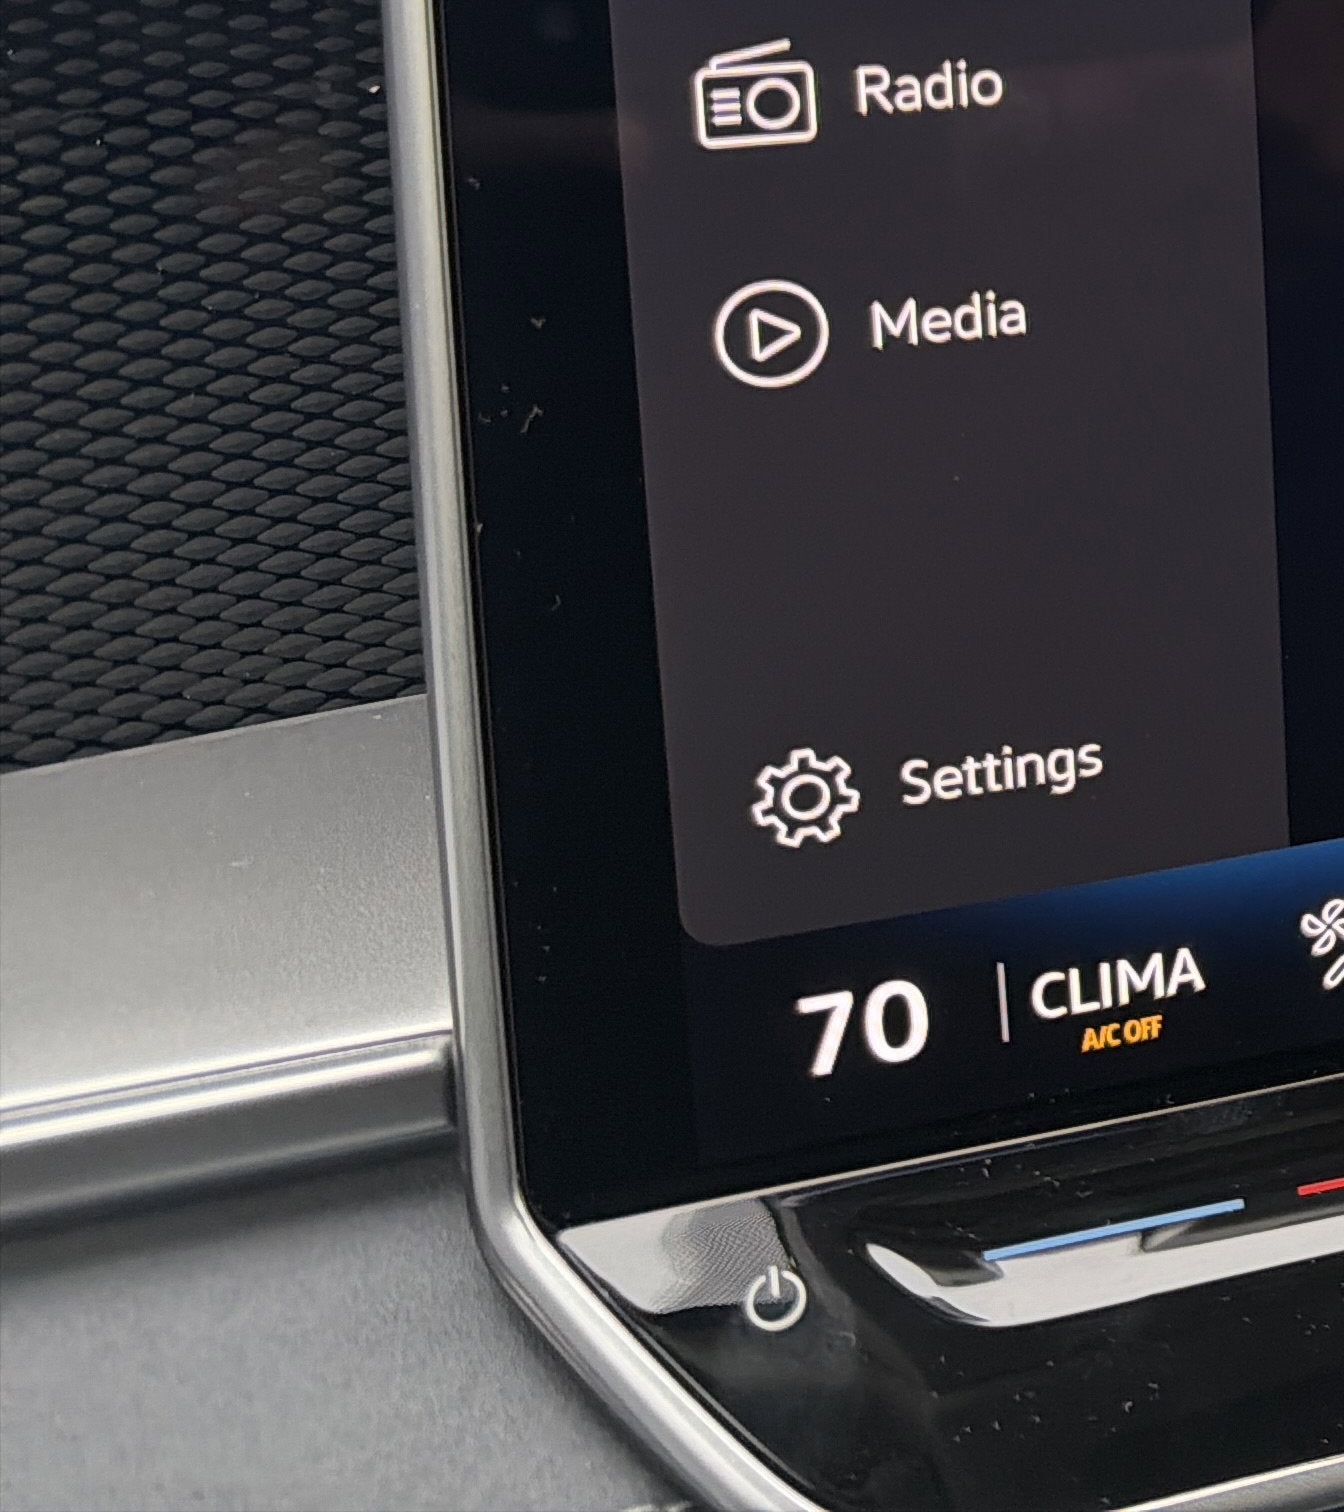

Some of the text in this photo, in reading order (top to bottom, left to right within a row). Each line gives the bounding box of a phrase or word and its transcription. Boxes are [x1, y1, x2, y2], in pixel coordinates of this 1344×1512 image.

[855, 59, 1004, 117] Radio
[870, 291, 1028, 350] Media
[900, 743, 1104, 806] Settings
[1030, 947, 1207, 1020] CLIMA
[795, 978, 931, 1077] 70
[1080, 1014, 1163, 1053] A/C OFF
